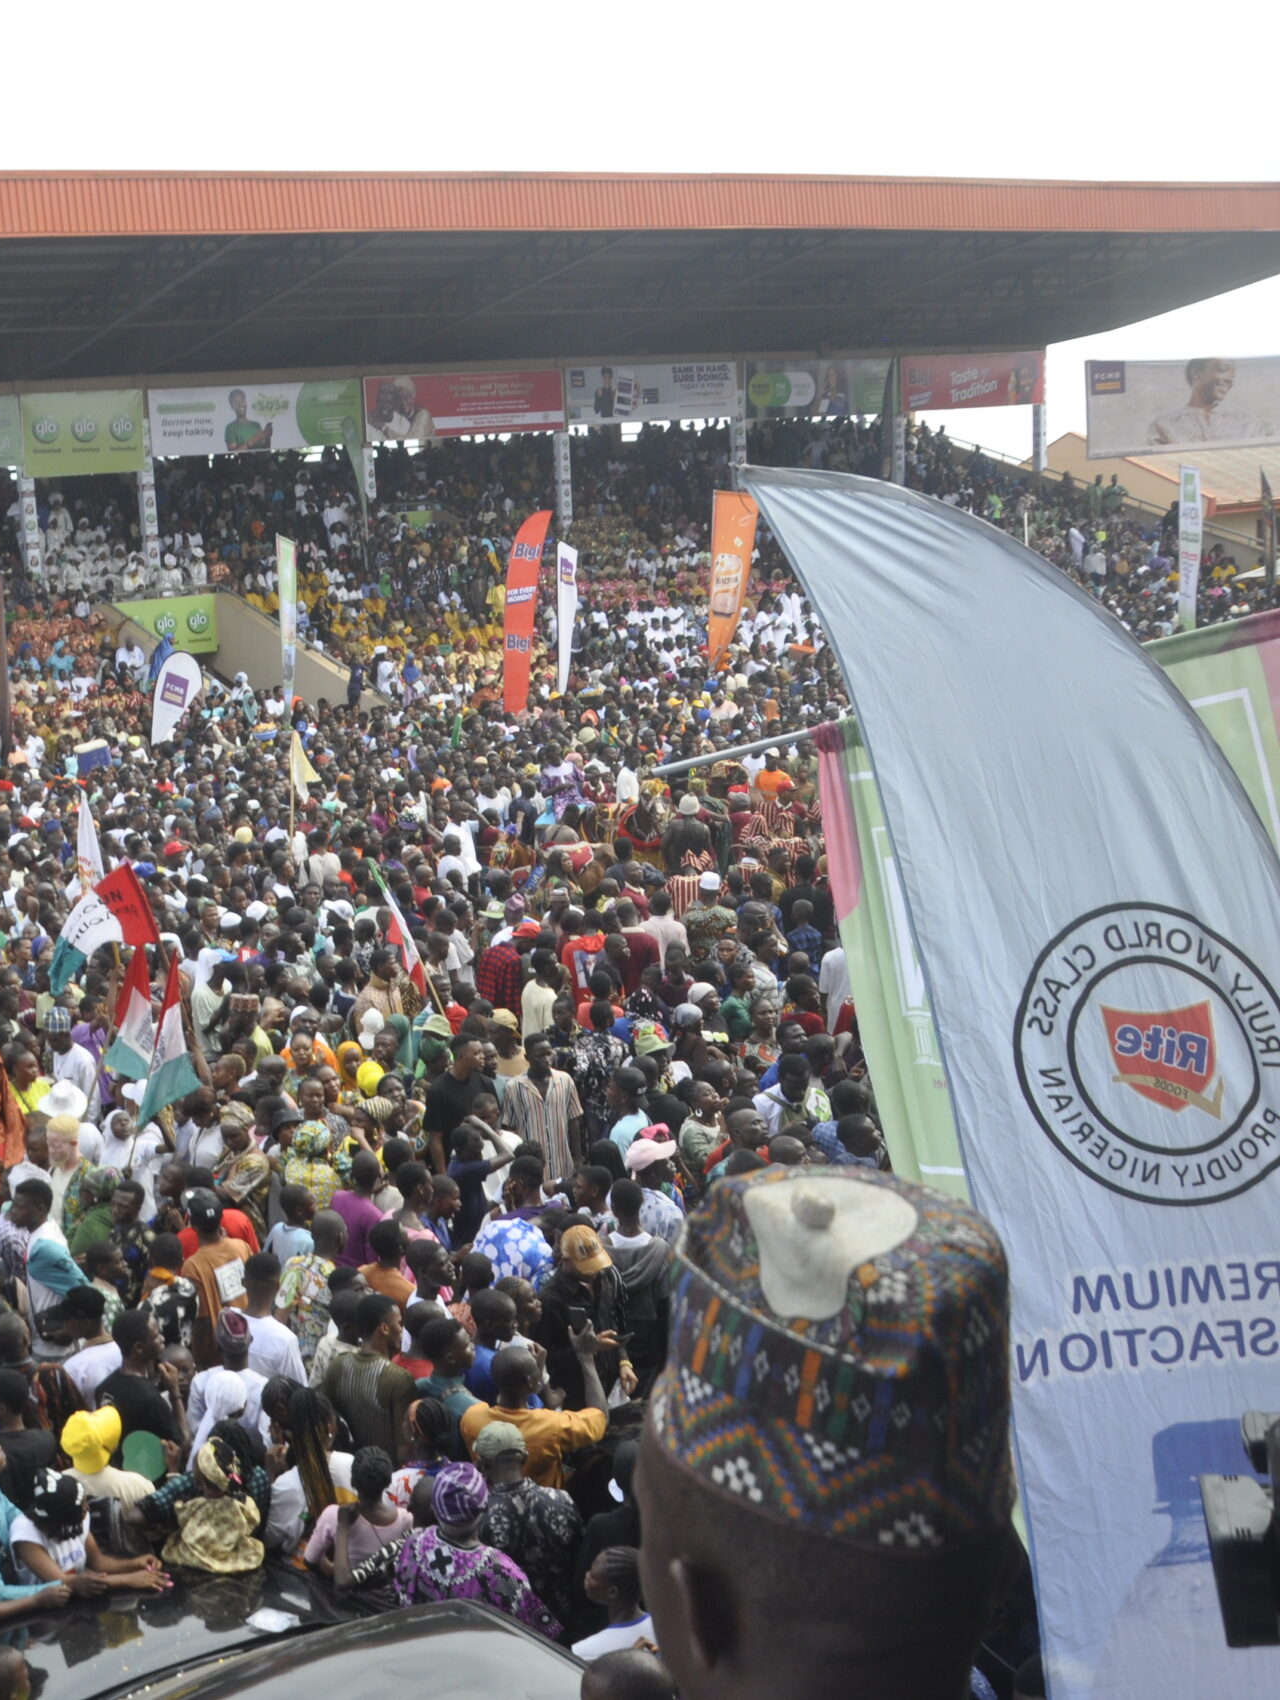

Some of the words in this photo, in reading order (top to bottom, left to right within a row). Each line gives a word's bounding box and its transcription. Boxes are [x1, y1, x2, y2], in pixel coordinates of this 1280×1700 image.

[671, 366, 694, 374] BANK
[696, 365, 705, 373] IN
[950, 367, 978, 386] Taste
[1094, 371, 1120, 381] FCMB
[672, 374, 696, 383] SURE
[950, 380, 998, 403] Tradition
[36, 419, 57, 437] glo
[74, 418, 95, 437] glo
[112, 418, 132, 437] glo
[161, 418, 191, 427] Borrow
[163, 428, 184, 438] keep
[185, 427, 214, 437] talking
[513, 543, 542, 561] Bigi
[507, 589, 519, 597] FOR
[519, 586, 537, 596] EVERY
[507, 594, 533, 603] MOMENT
[157, 617, 175, 633] glo
[189, 615, 207, 629] glo
[506, 634, 532, 653] Bigi
[165, 682, 185, 695] FCMB
